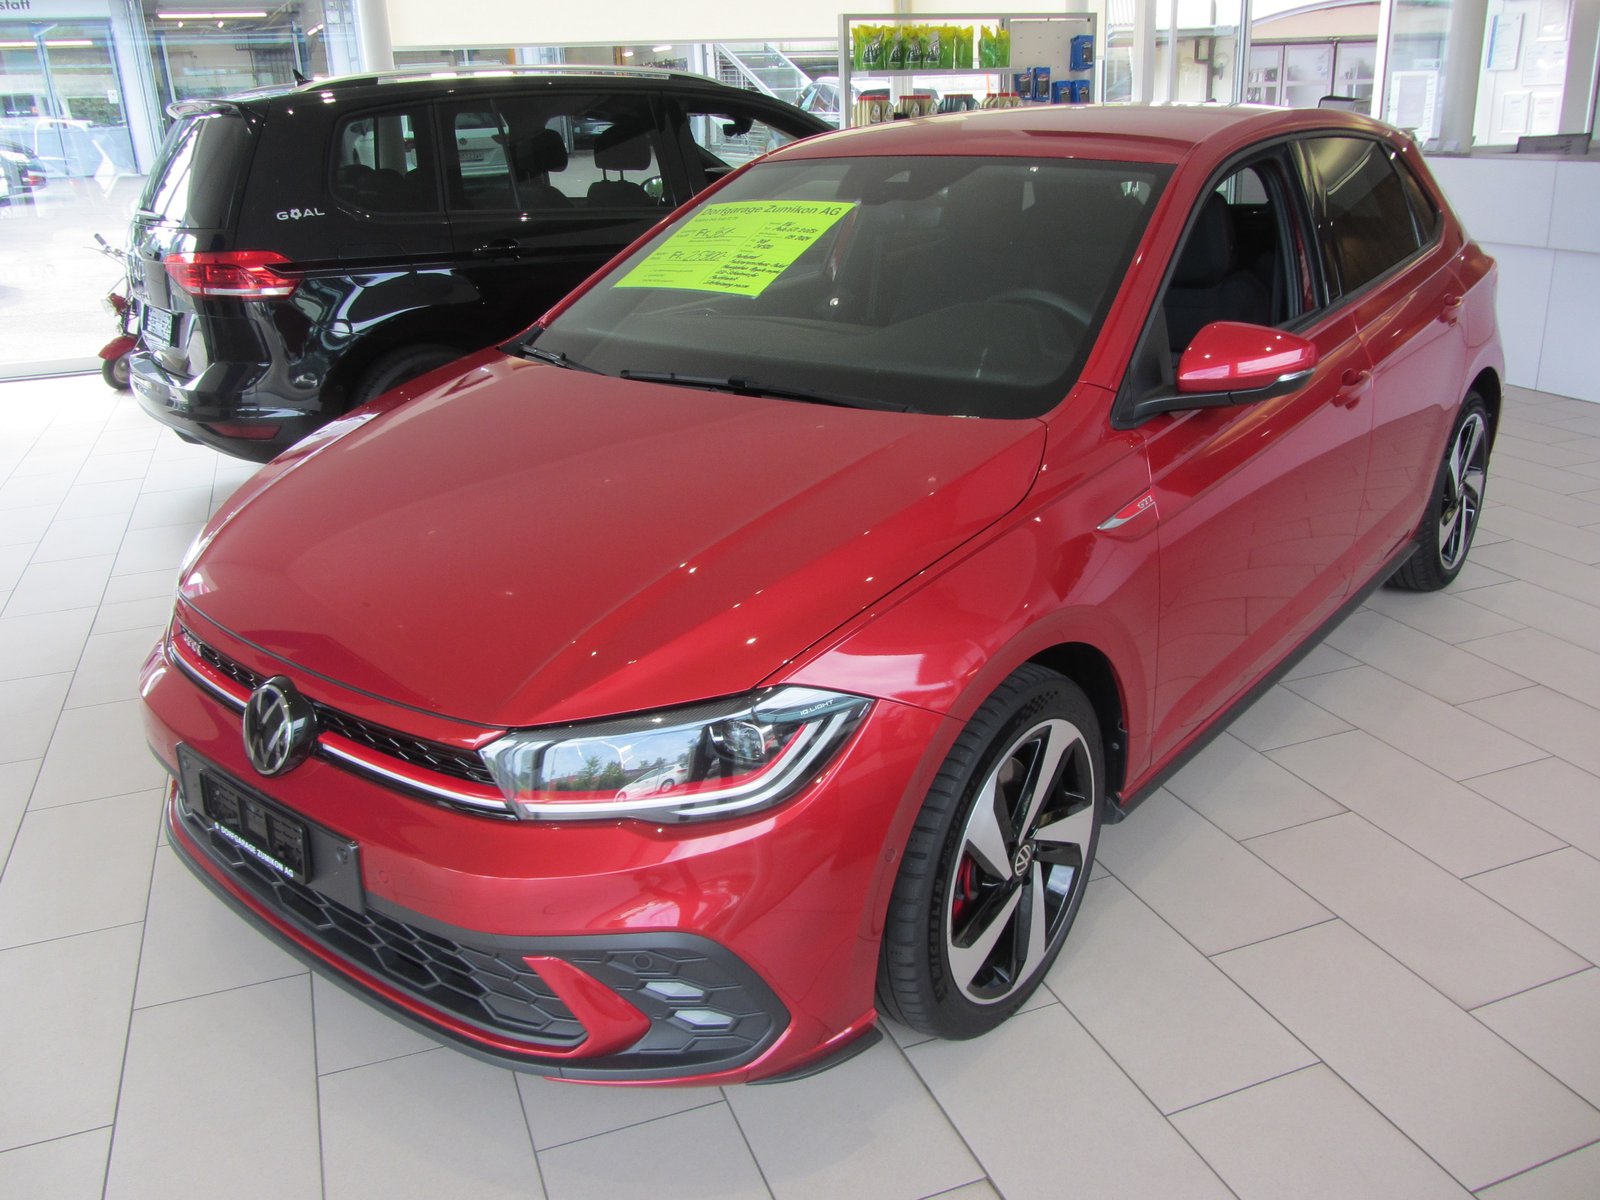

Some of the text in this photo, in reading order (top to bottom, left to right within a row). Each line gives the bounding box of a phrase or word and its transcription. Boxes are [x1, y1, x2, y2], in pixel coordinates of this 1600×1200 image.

[702, 204, 842, 217] Dorfgarage Zumikon AG
